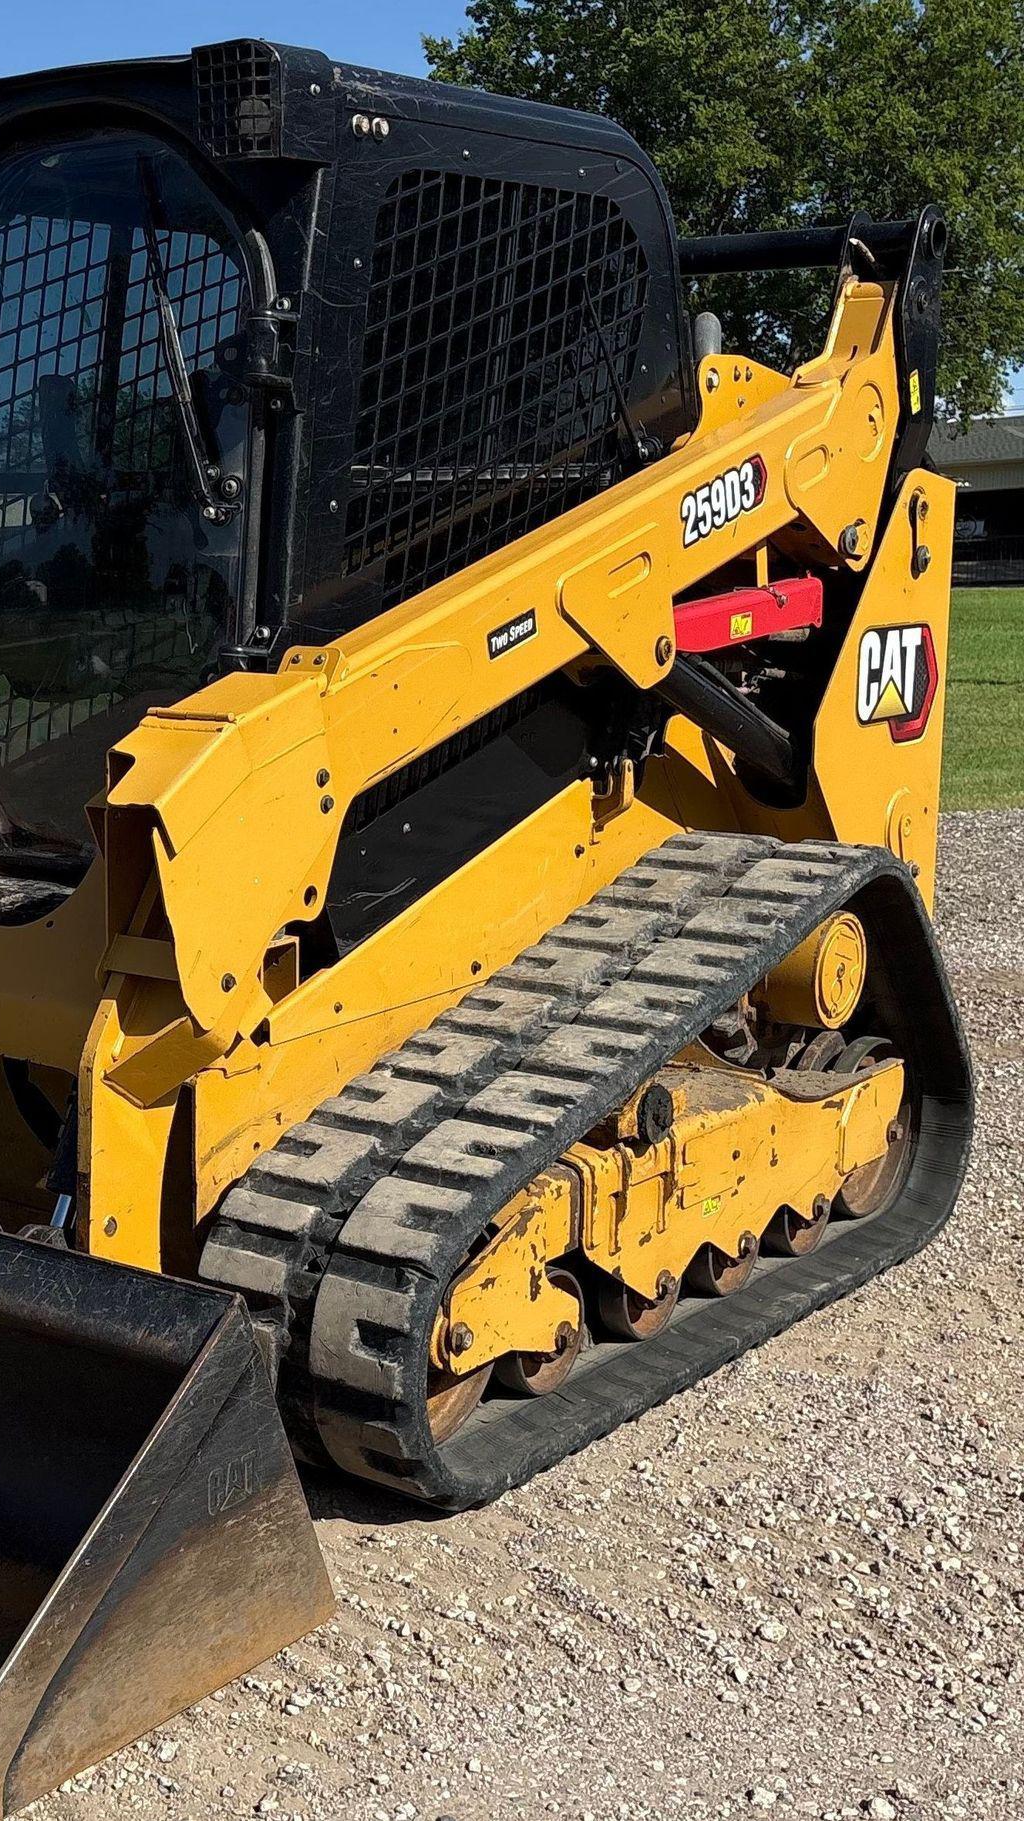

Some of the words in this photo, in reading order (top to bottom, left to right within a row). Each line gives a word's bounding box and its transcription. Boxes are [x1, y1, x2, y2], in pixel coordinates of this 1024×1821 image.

[681, 461, 756, 546] 259D3
[857, 626, 923, 721] CAT
[208, 1449, 257, 1516] CAT
